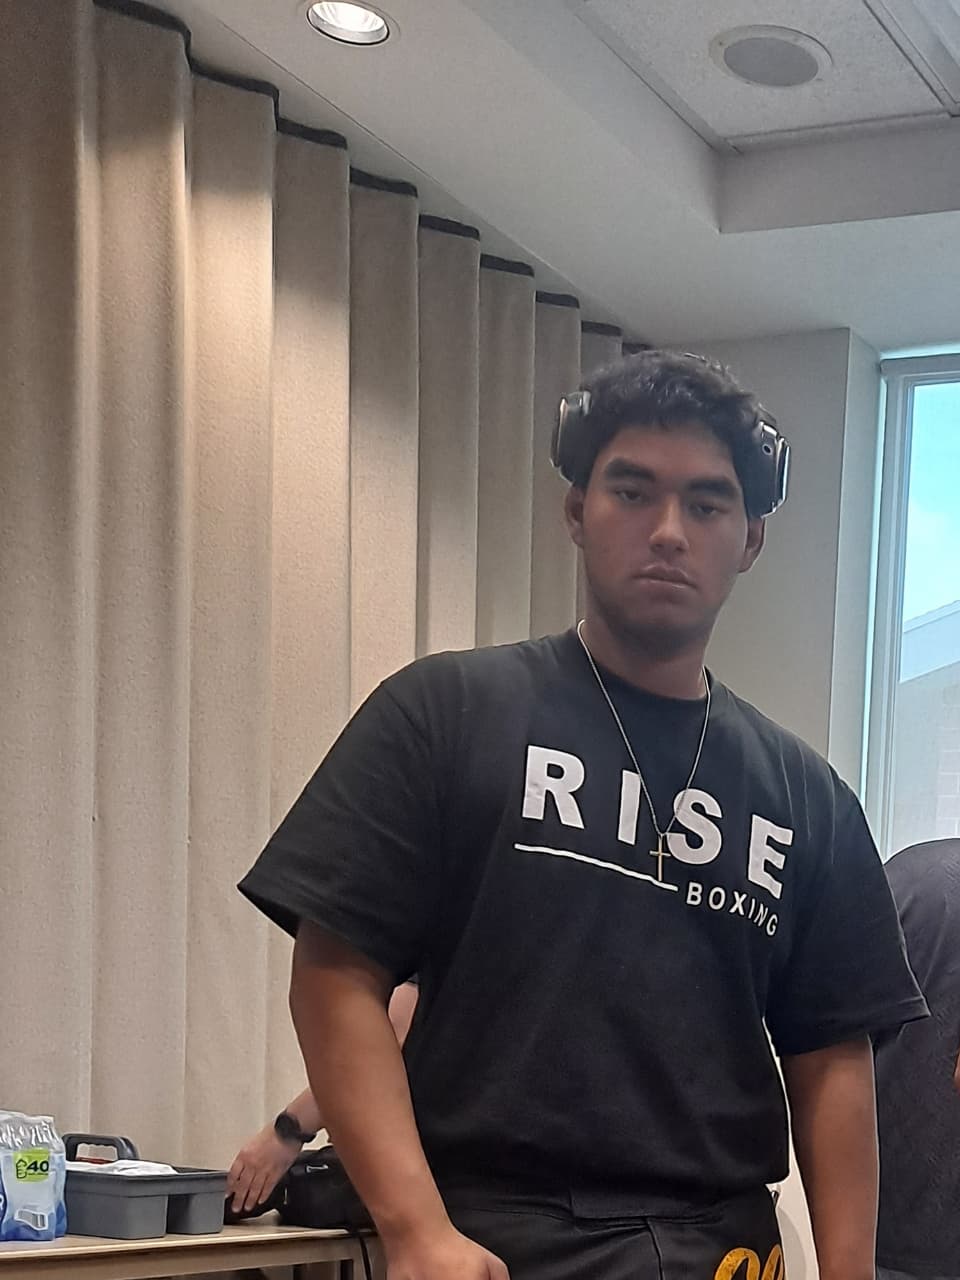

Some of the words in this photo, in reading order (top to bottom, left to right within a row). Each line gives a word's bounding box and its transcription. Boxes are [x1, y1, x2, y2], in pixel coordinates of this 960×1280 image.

[521, 744, 793, 899] RISE
[685, 881, 778, 936] BOXING
[27, 1160, 50, 1173] 40
